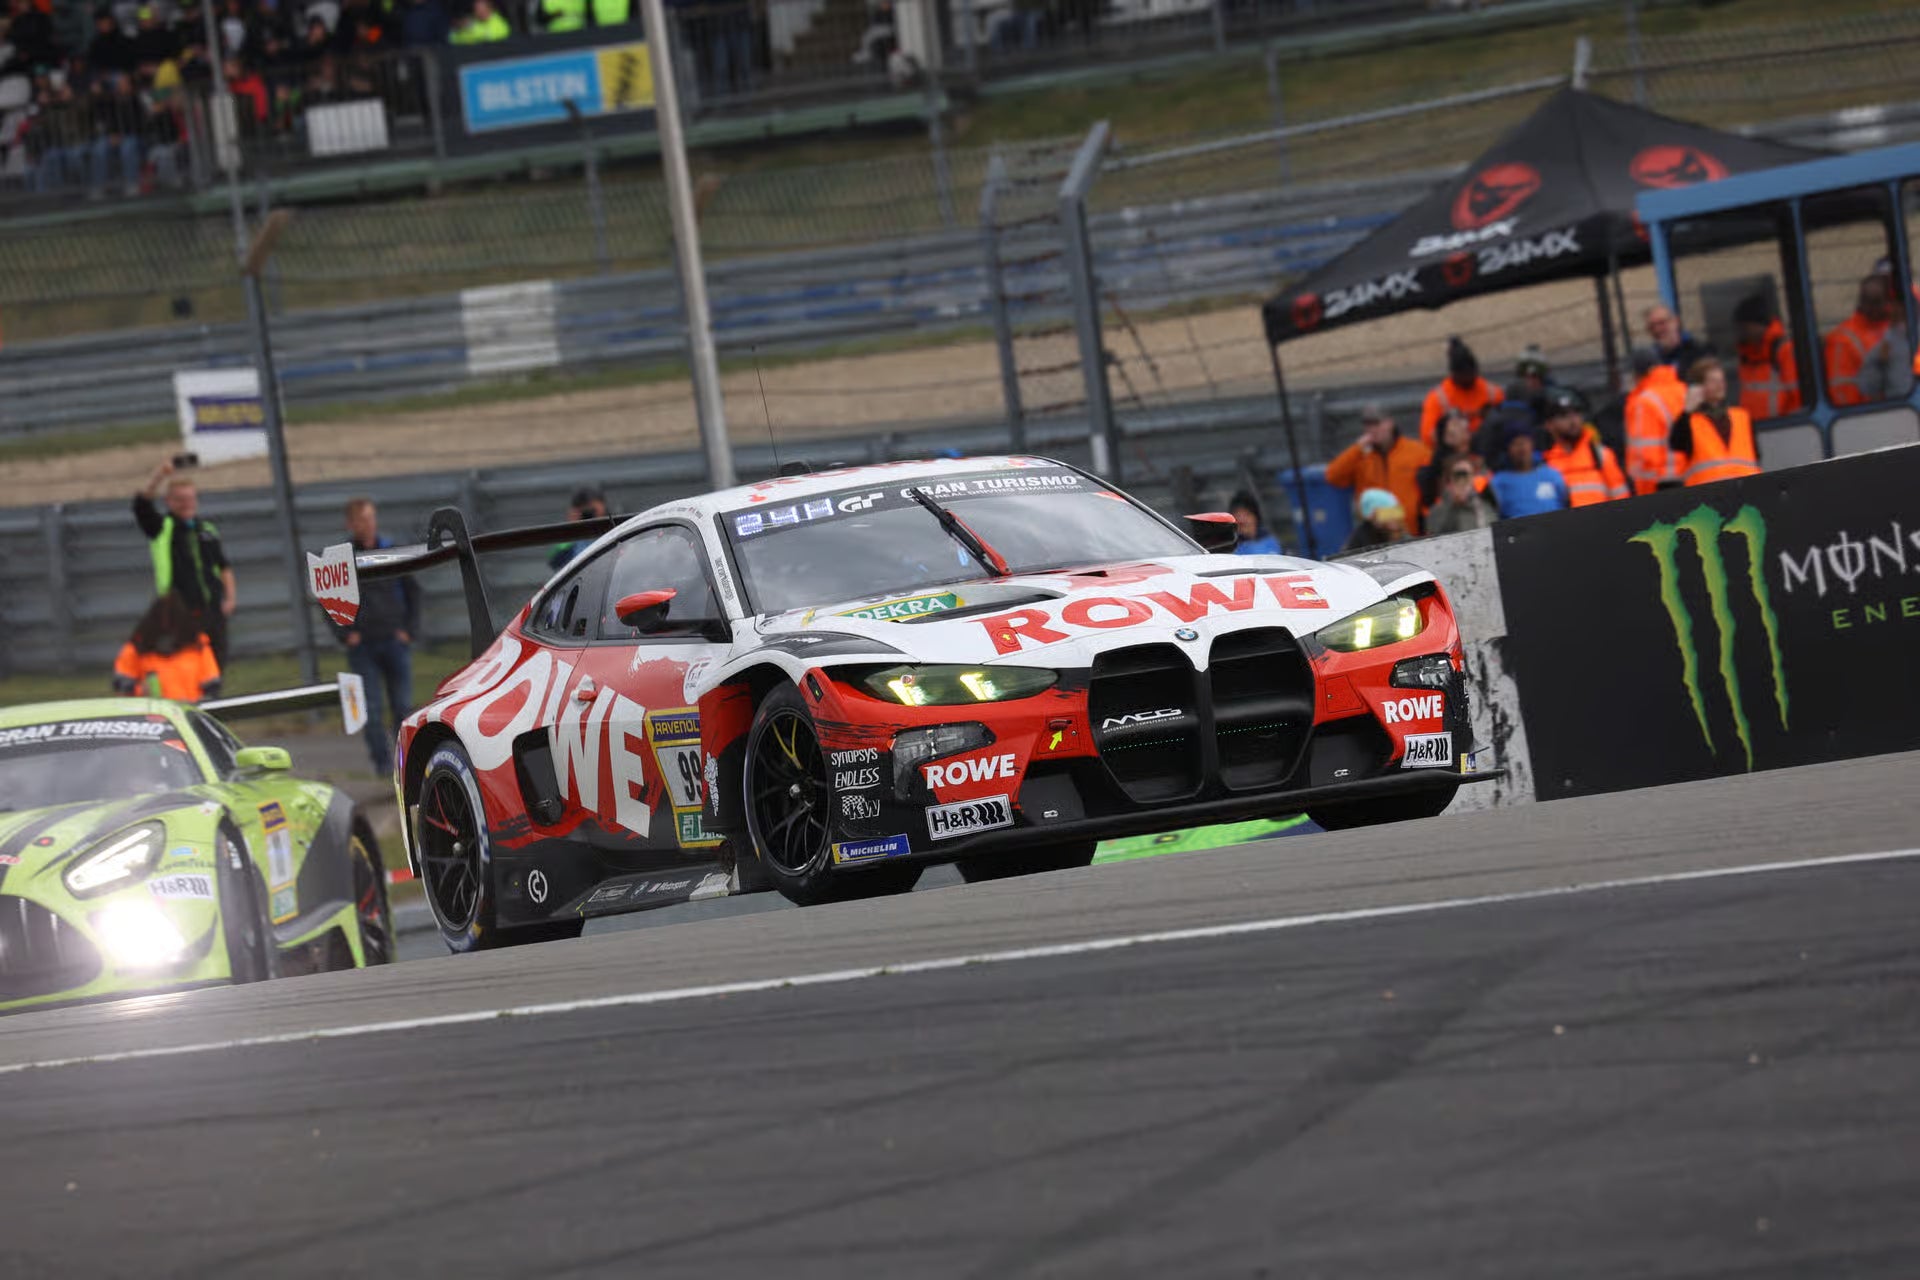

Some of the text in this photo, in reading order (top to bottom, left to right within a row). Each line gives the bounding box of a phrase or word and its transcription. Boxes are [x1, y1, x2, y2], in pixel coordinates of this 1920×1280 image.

[314, 562, 350, 593] ROWE
[852, 597, 949, 621] DEKRA
[963, 575, 1330, 655] ROWE
[1381, 695, 1443, 724] ROWE
[61, 720, 166, 736] TURISMO
[402, 634, 650, 839] ROWE
[831, 747, 878, 767] SYNOPSYS
[835, 767, 880, 788] ENDLESS
[925, 753, 1016, 790] ROWE
[930, 807, 977, 832] H&R
[850, 843, 897, 856] MICHELIN
